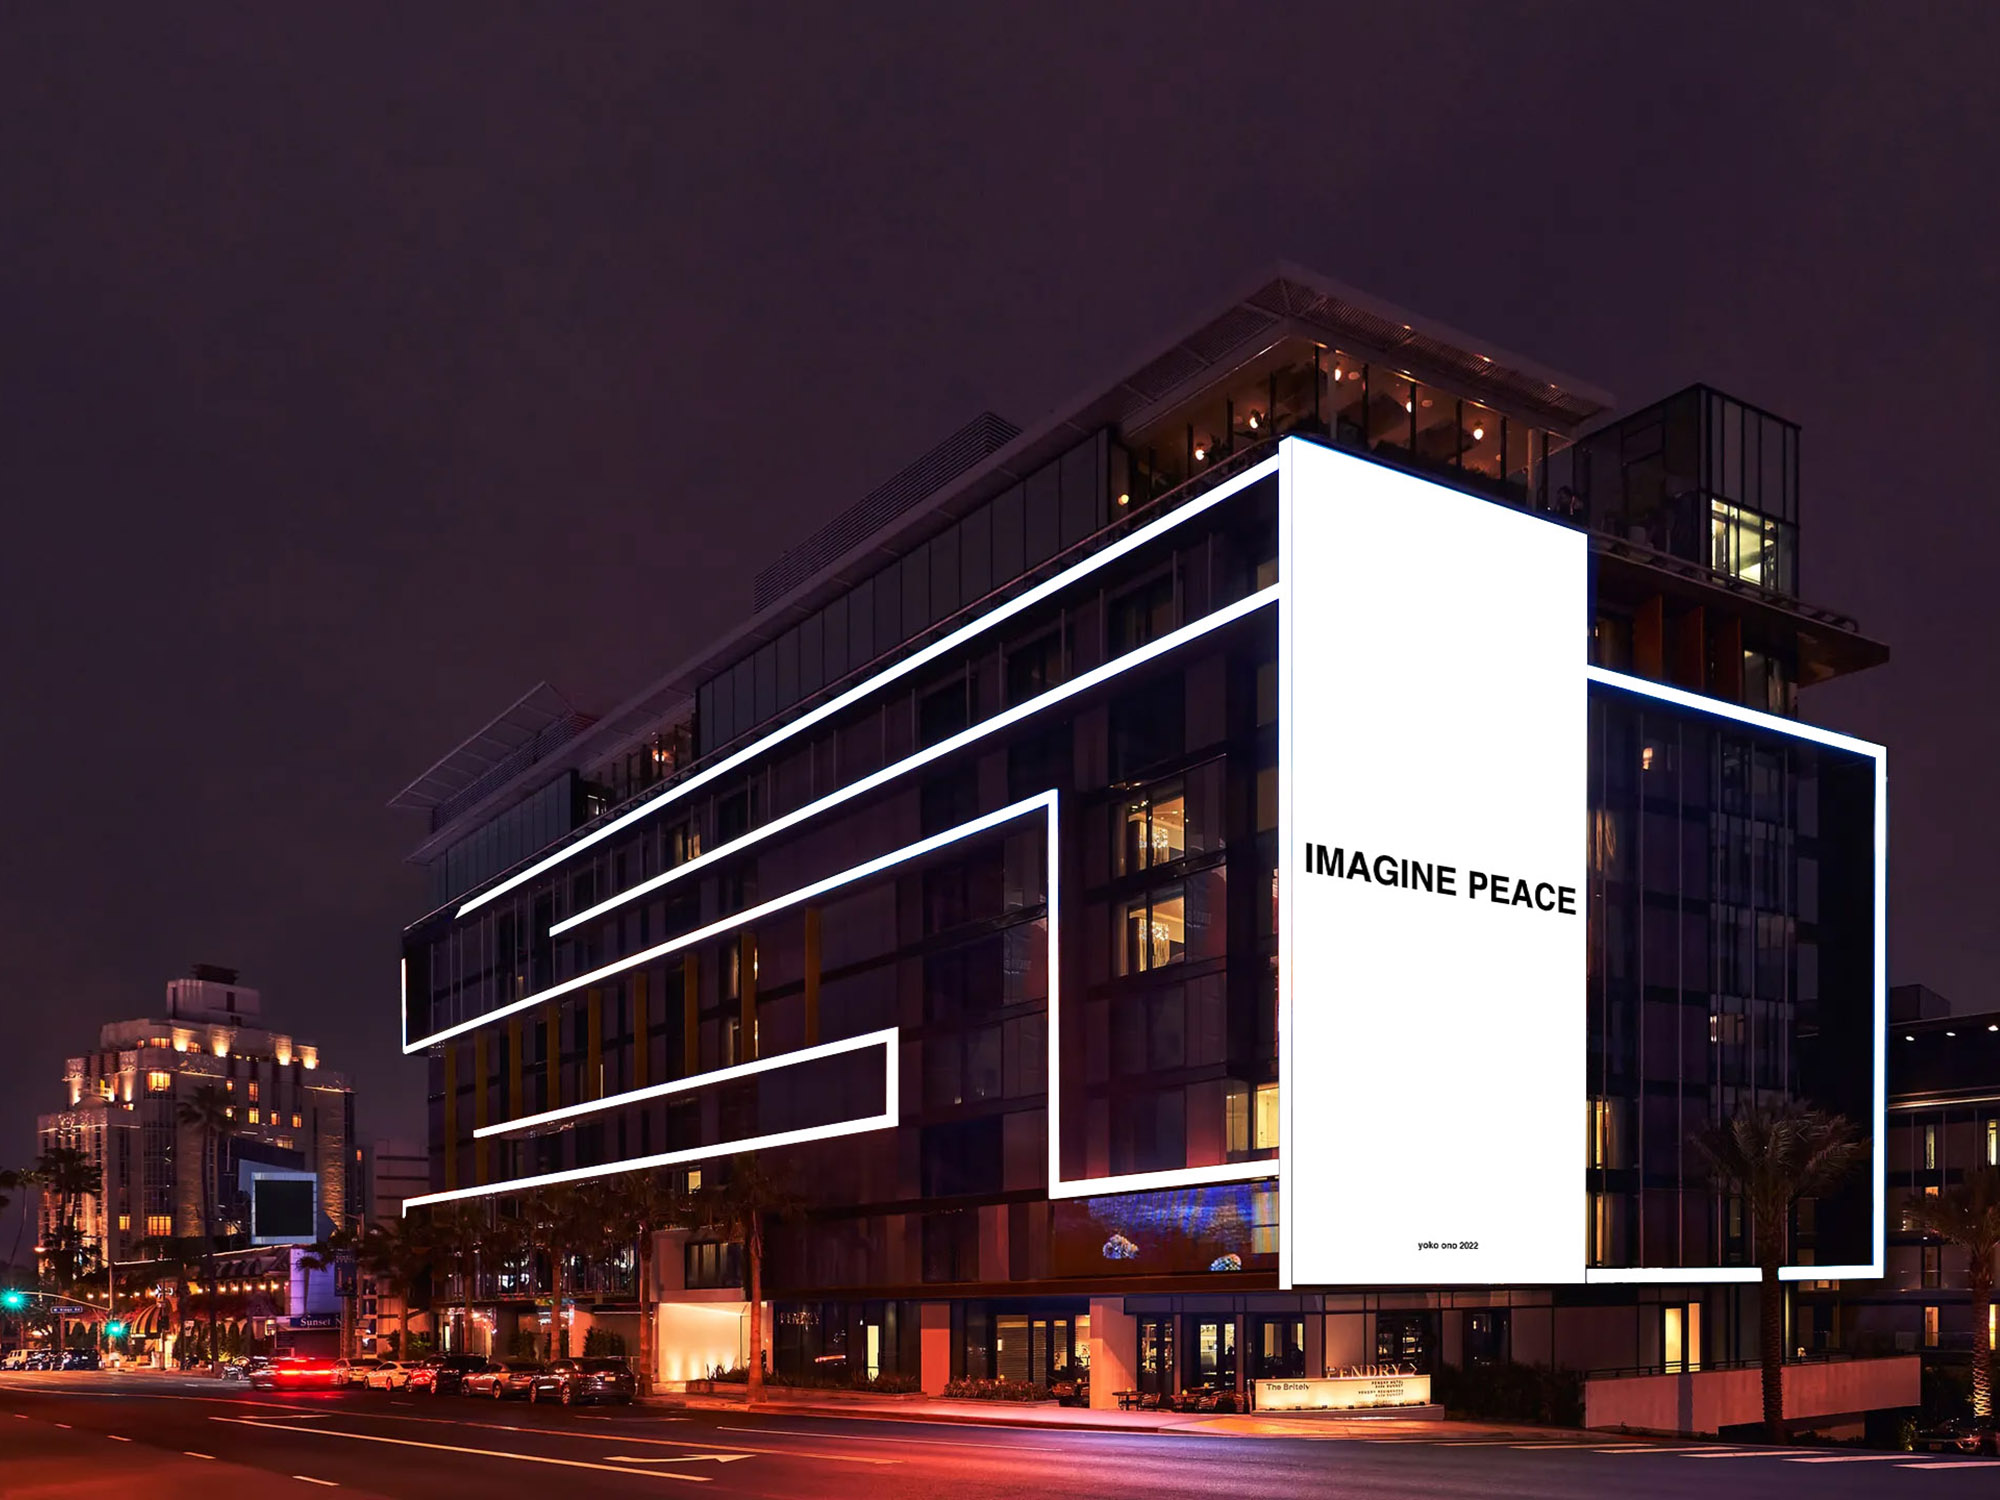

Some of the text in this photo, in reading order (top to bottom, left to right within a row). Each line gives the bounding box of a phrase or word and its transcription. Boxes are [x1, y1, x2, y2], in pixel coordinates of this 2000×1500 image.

[1306, 842, 1577, 915] IMAGINE PEACE
[1418, 1241, 1479, 1251] yoko ono 2022
[1326, 1363, 1401, 1379] PENDRY
[1266, 1383, 1310, 1392] The Britely
